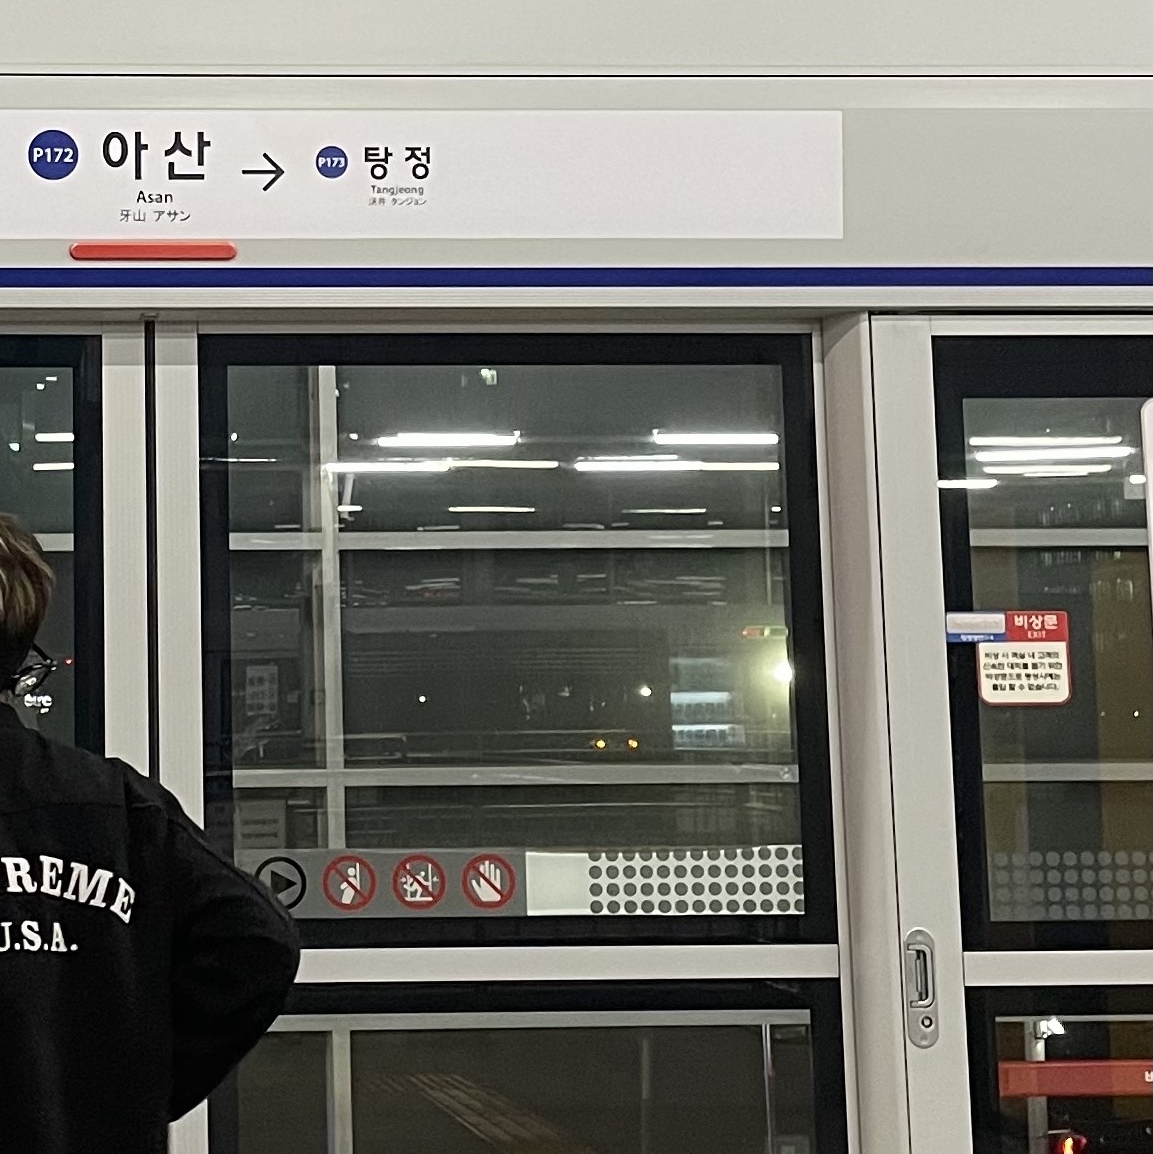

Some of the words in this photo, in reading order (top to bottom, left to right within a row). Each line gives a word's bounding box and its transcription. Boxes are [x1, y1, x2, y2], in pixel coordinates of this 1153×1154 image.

[33, 148, 74, 164] P172
[318, 157, 346, 168] P173
[136, 190, 174, 204] Asan
[370, 184, 425, 196] Tangjeong
[1014, 614, 1058, 630] 비상문
